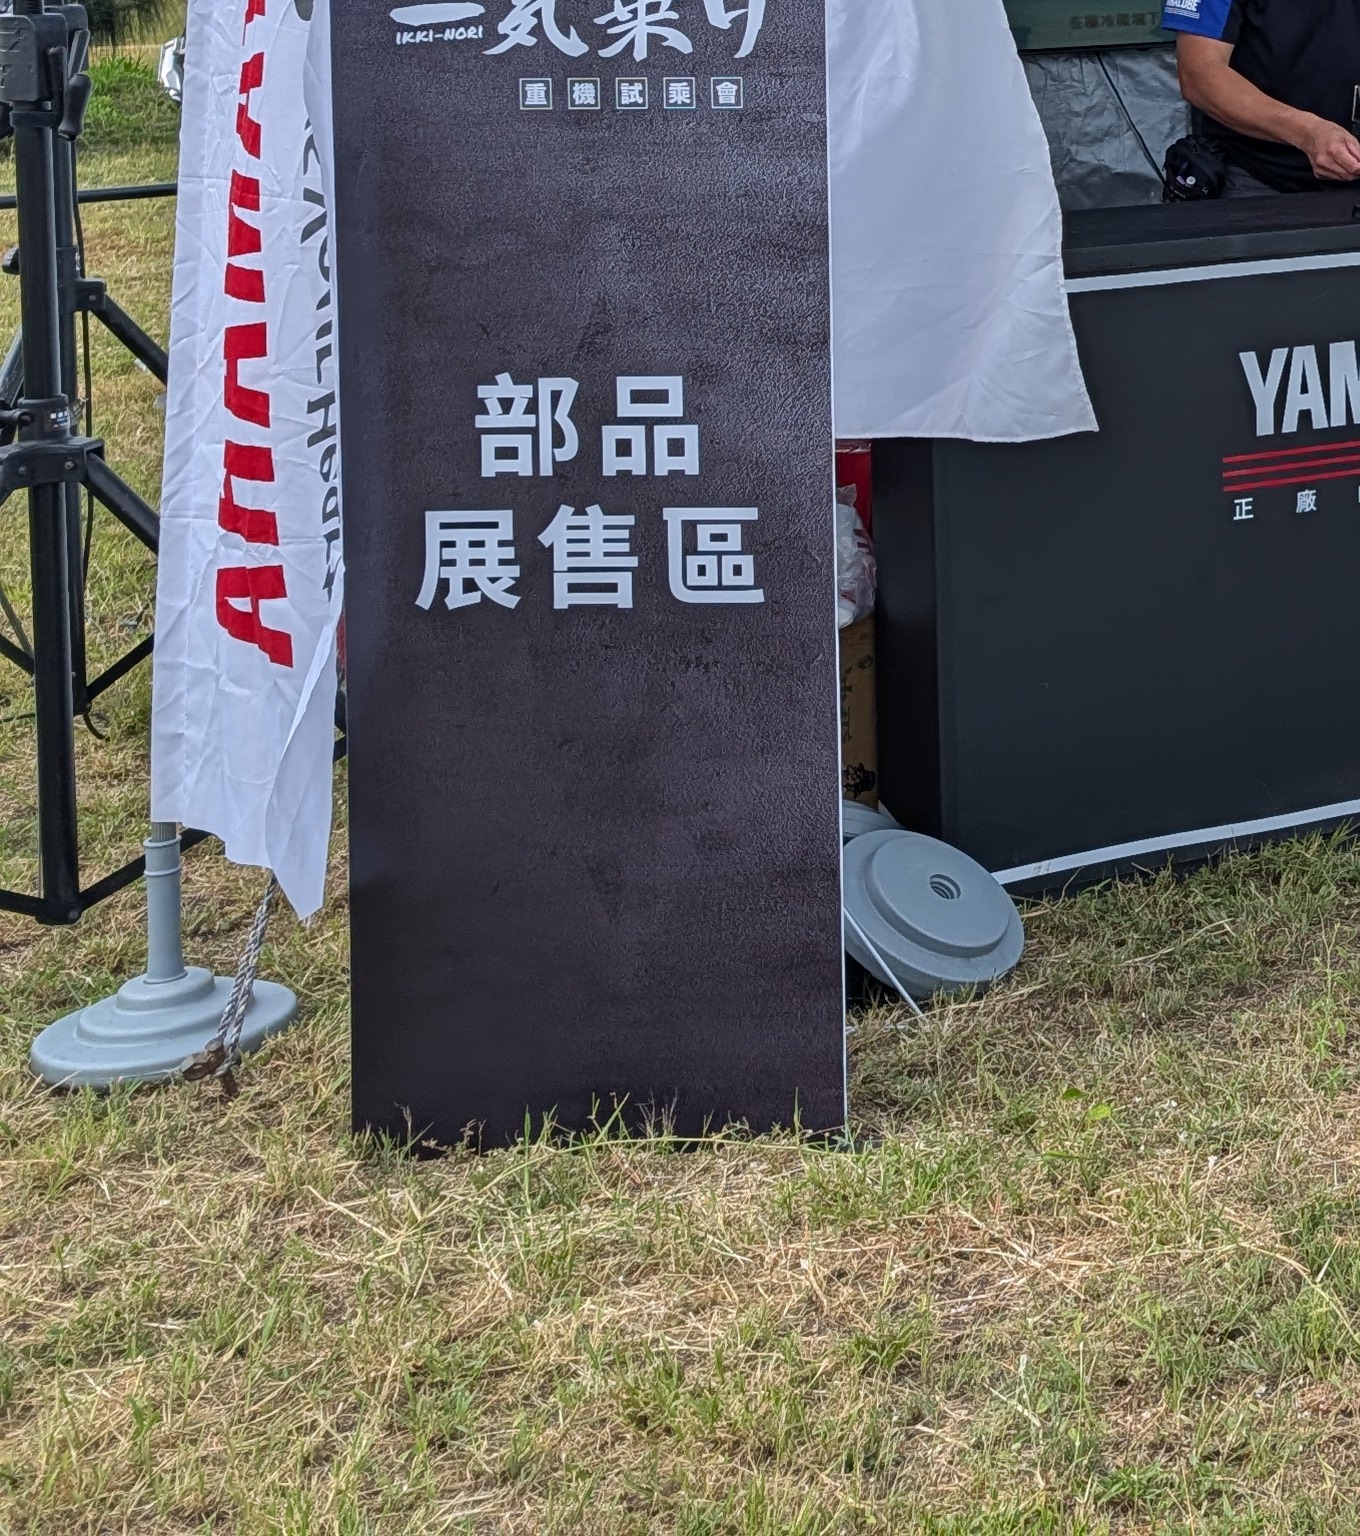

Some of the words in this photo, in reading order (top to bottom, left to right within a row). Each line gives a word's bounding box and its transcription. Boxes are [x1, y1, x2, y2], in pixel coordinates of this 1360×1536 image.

[395, 25, 484, 46] IKKI-NORI
[474, 371, 701, 478] 部品
[415, 504, 766, 611] 展售區
